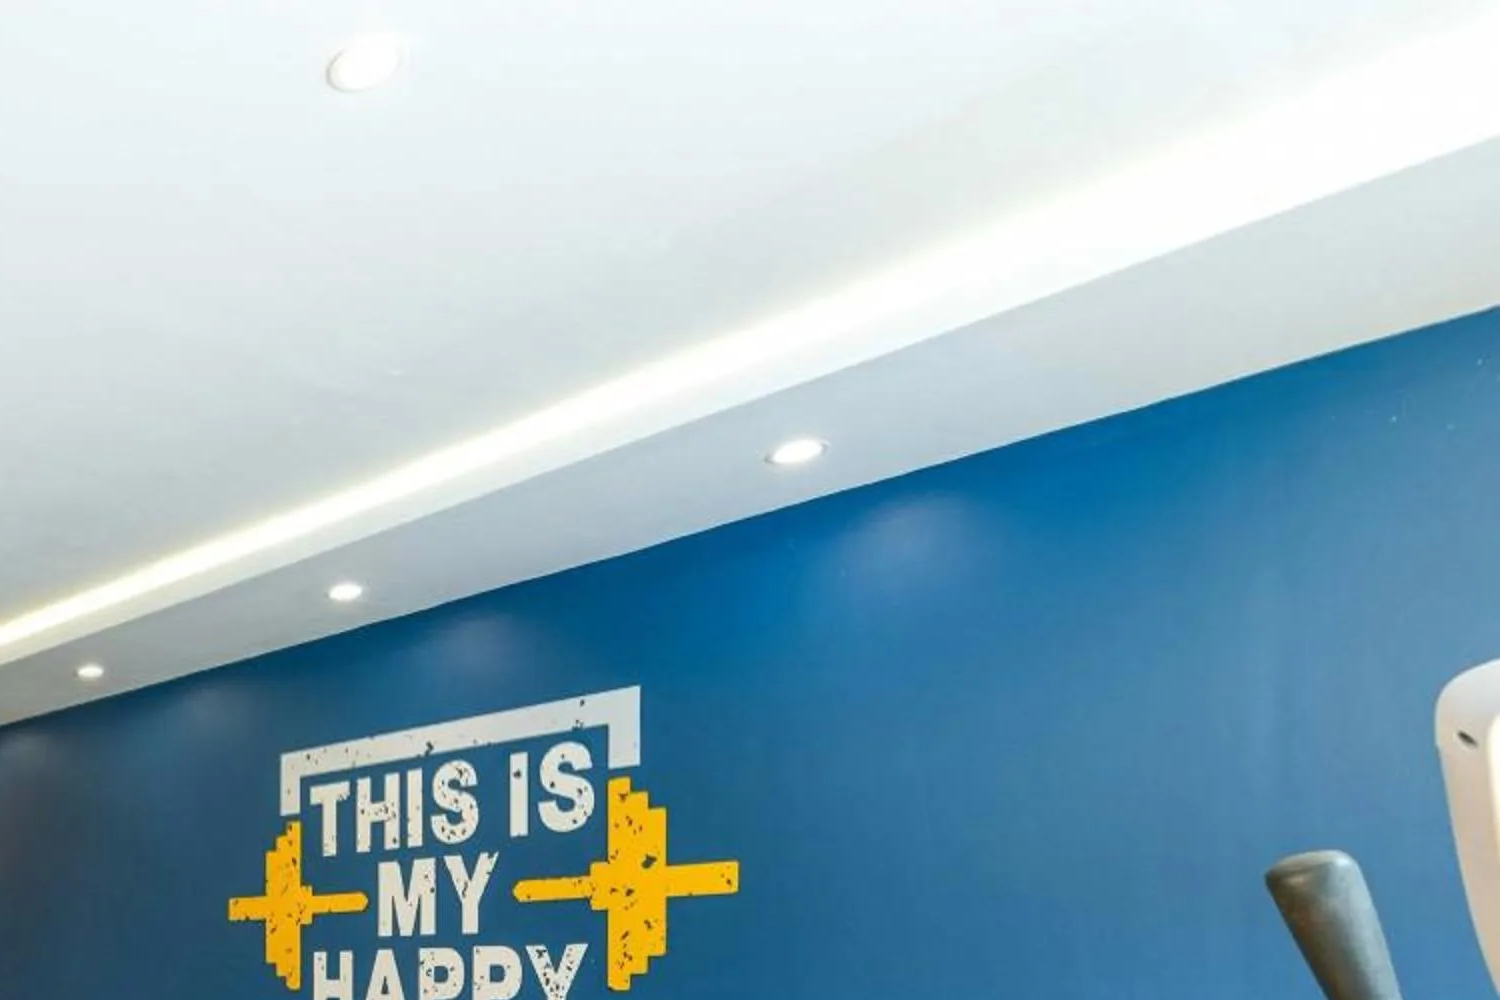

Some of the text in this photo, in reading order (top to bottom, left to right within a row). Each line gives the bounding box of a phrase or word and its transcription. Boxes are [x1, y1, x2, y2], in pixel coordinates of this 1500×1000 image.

[309, 741, 596, 857] THIS IS
[377, 851, 499, 937] MY
